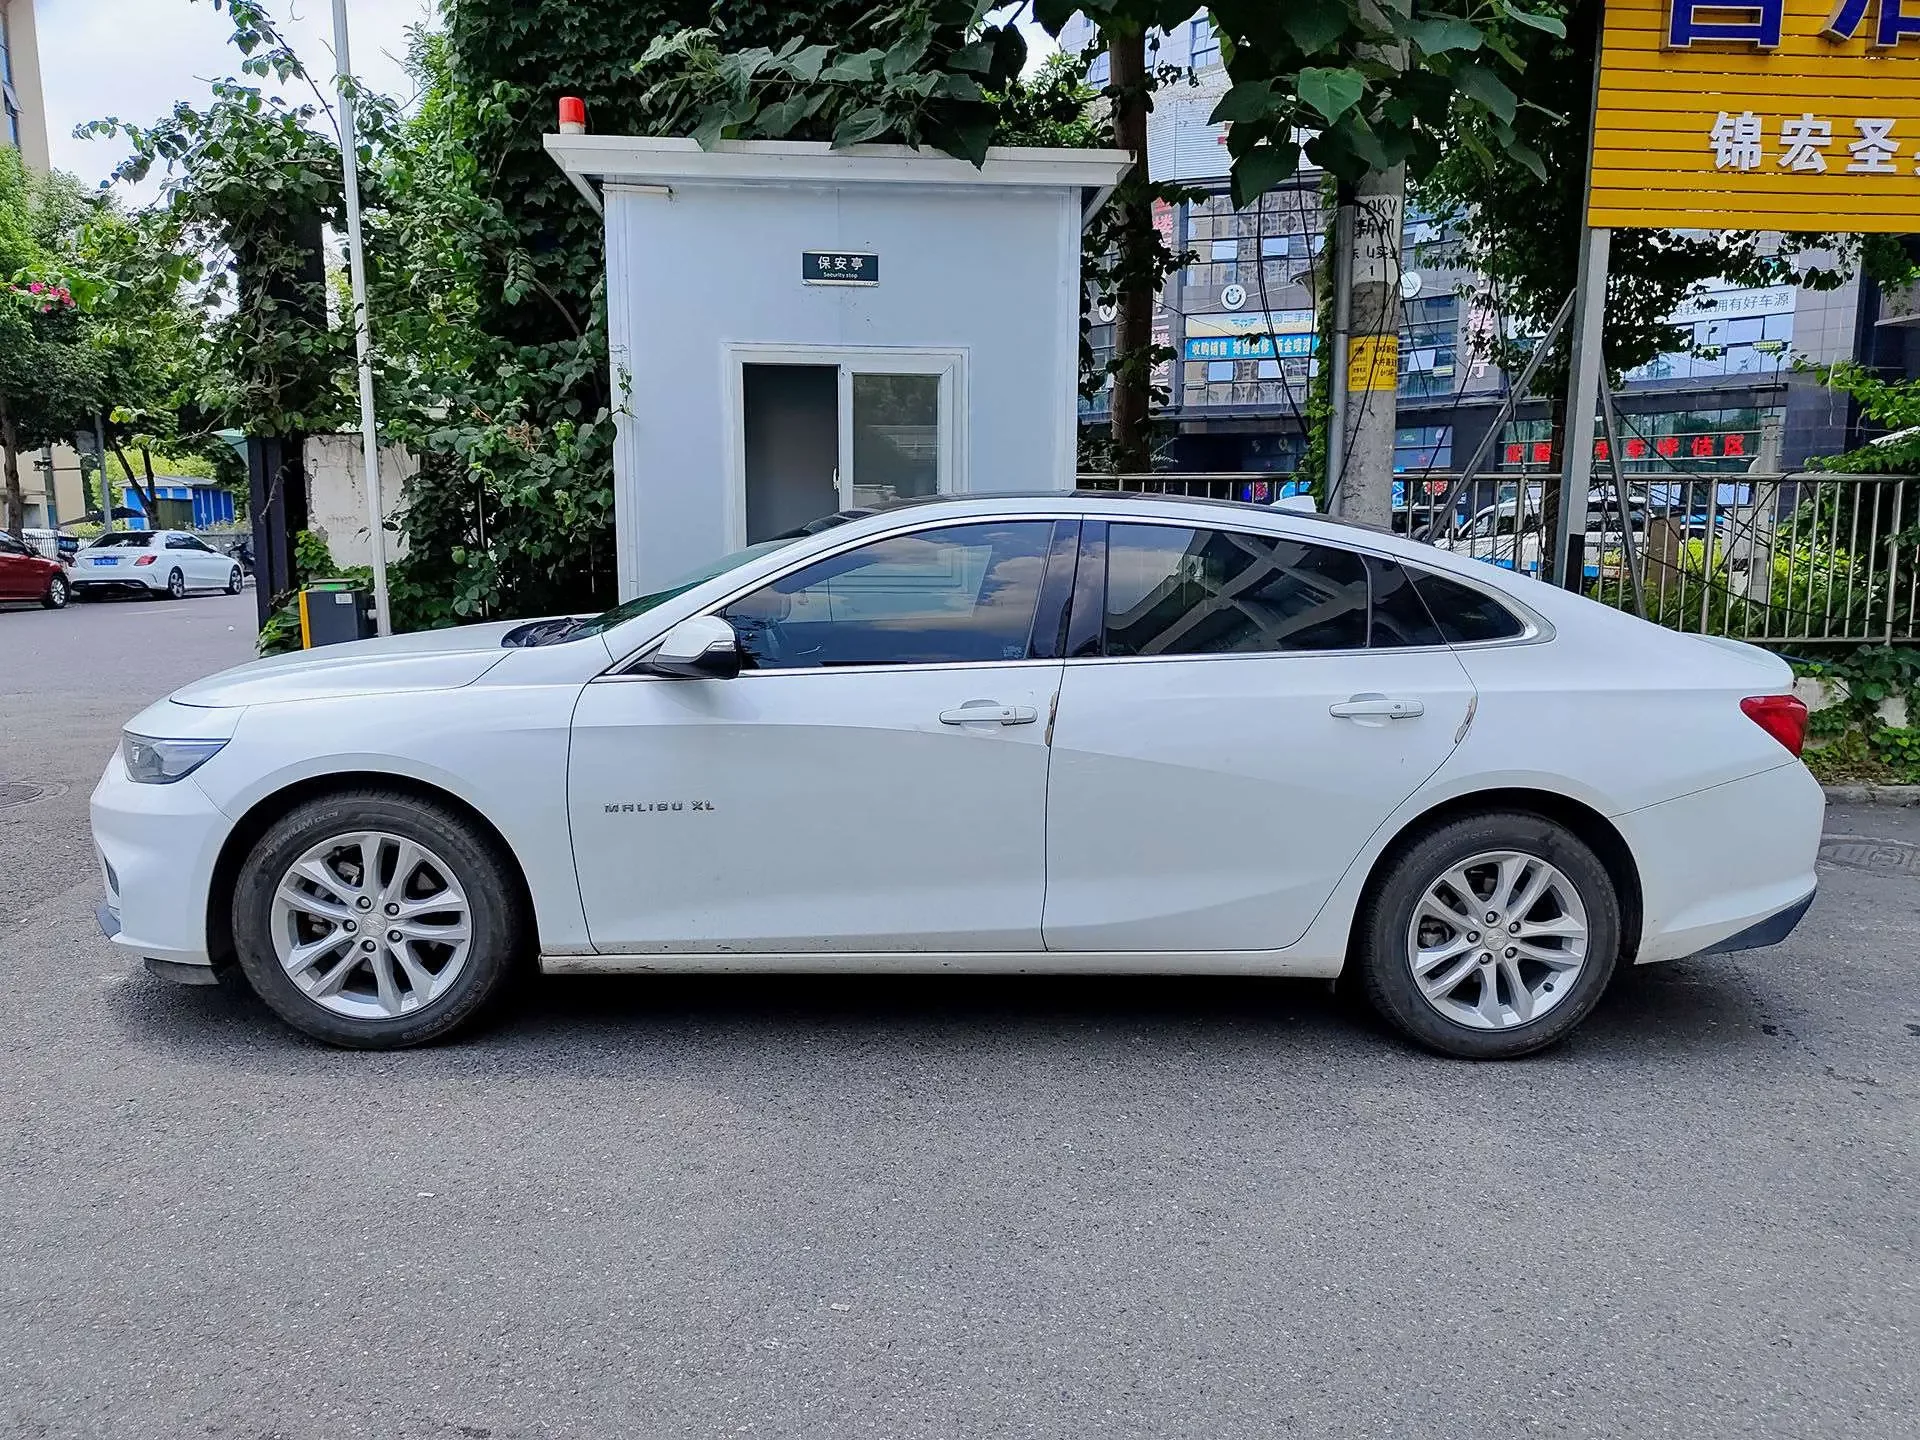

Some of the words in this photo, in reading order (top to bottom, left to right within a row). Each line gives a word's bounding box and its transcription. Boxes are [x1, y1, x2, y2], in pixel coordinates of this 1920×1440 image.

[1709, 111, 1920, 174] 锦宏圣
[818, 255, 864, 271] 保安亭
[823, 271, 845, 279] Security
[604, 802, 684, 813] MALIBU
[691, 800, 715, 811] XL
